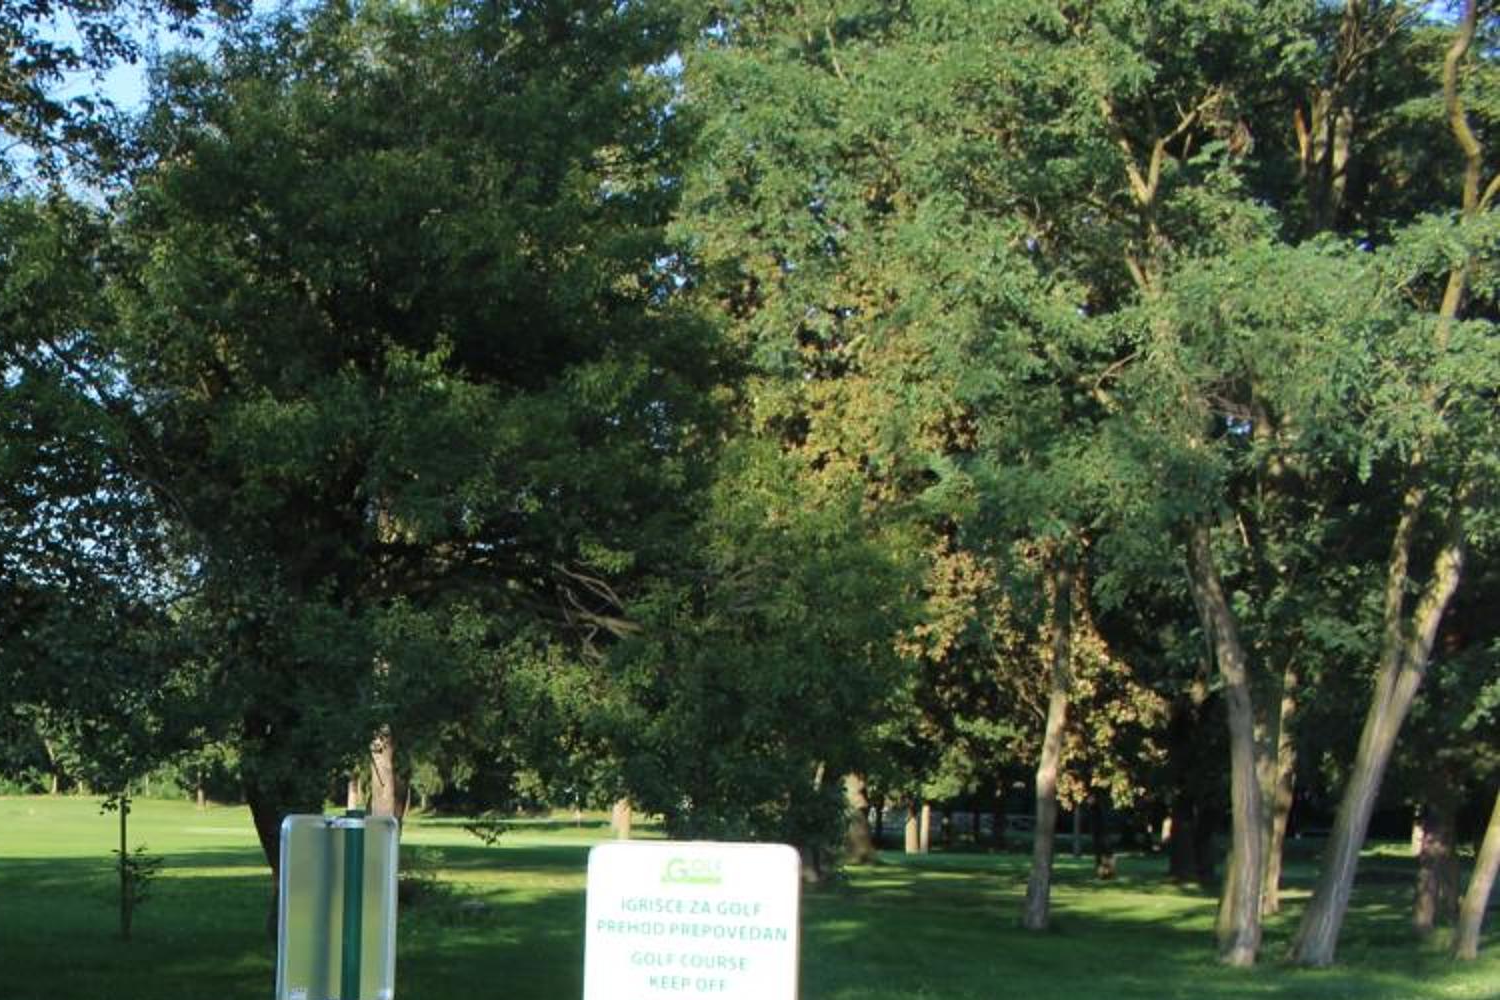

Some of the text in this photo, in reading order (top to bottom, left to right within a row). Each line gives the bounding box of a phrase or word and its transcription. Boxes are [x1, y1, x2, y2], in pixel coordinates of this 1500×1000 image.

[689, 901, 711, 915] ZA
[717, 902, 763, 917] GOLF
[596, 919, 788, 942] PREHOD PREPOVEDAN
[630, 951, 748, 971] GOLF COURSE
[649, 976, 728, 992] KEEP OFF
